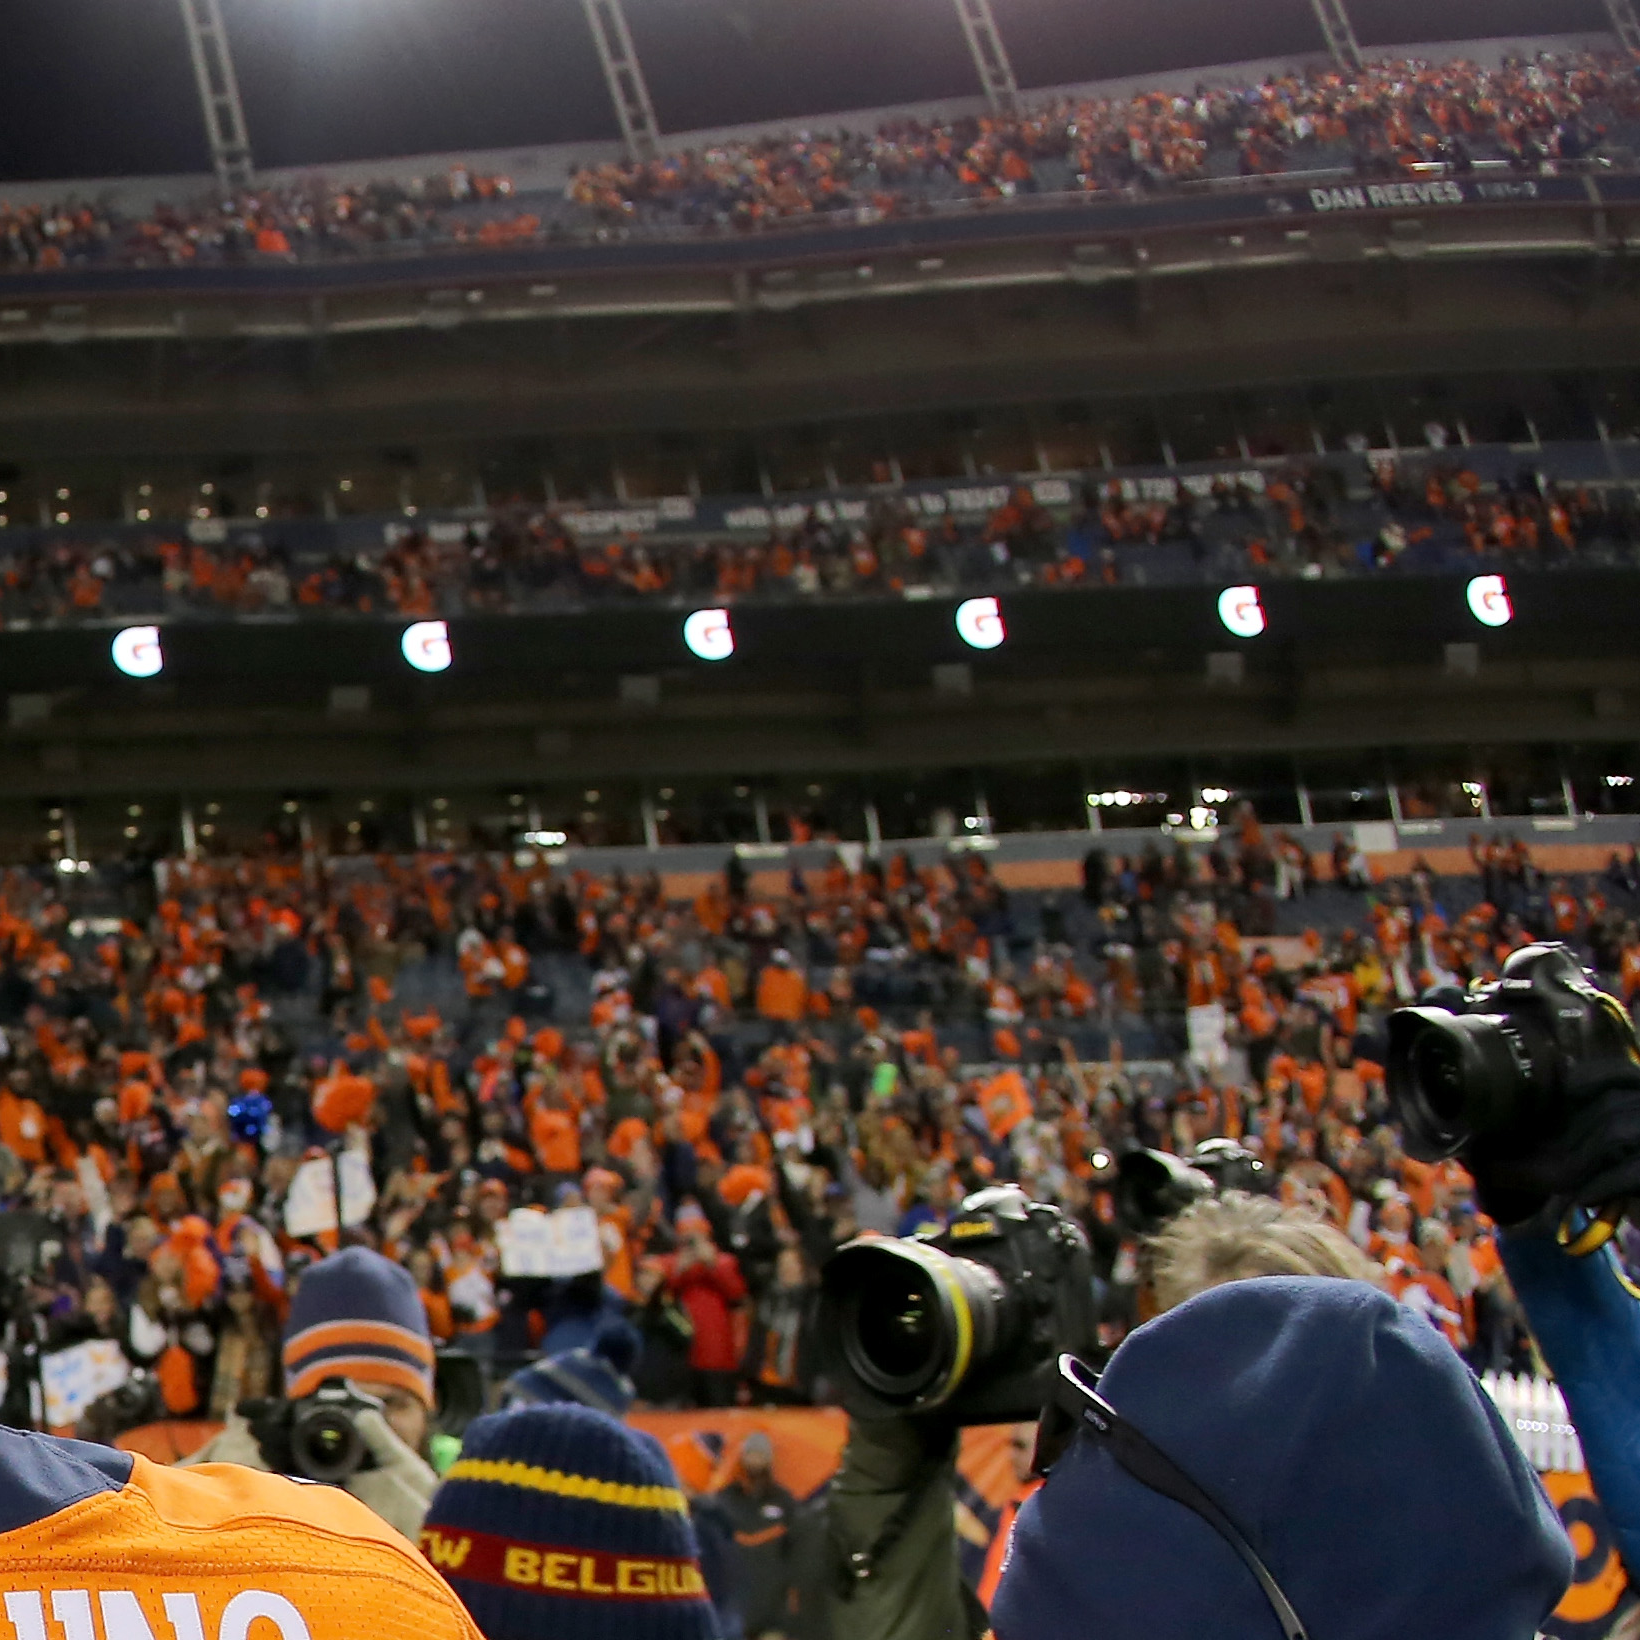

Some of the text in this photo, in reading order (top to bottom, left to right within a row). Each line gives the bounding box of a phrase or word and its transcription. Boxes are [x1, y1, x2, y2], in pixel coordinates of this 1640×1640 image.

[1309, 186, 1367, 213] DAN
[1367, 180, 1464, 207] REEVES
[955, 597, 1005, 649] G
[1218, 585, 1266, 637] G
[1467, 575, 1512, 627] G
[111, 625, 163, 677] G
[401, 620, 452, 672] G
[684, 608, 735, 660] G
